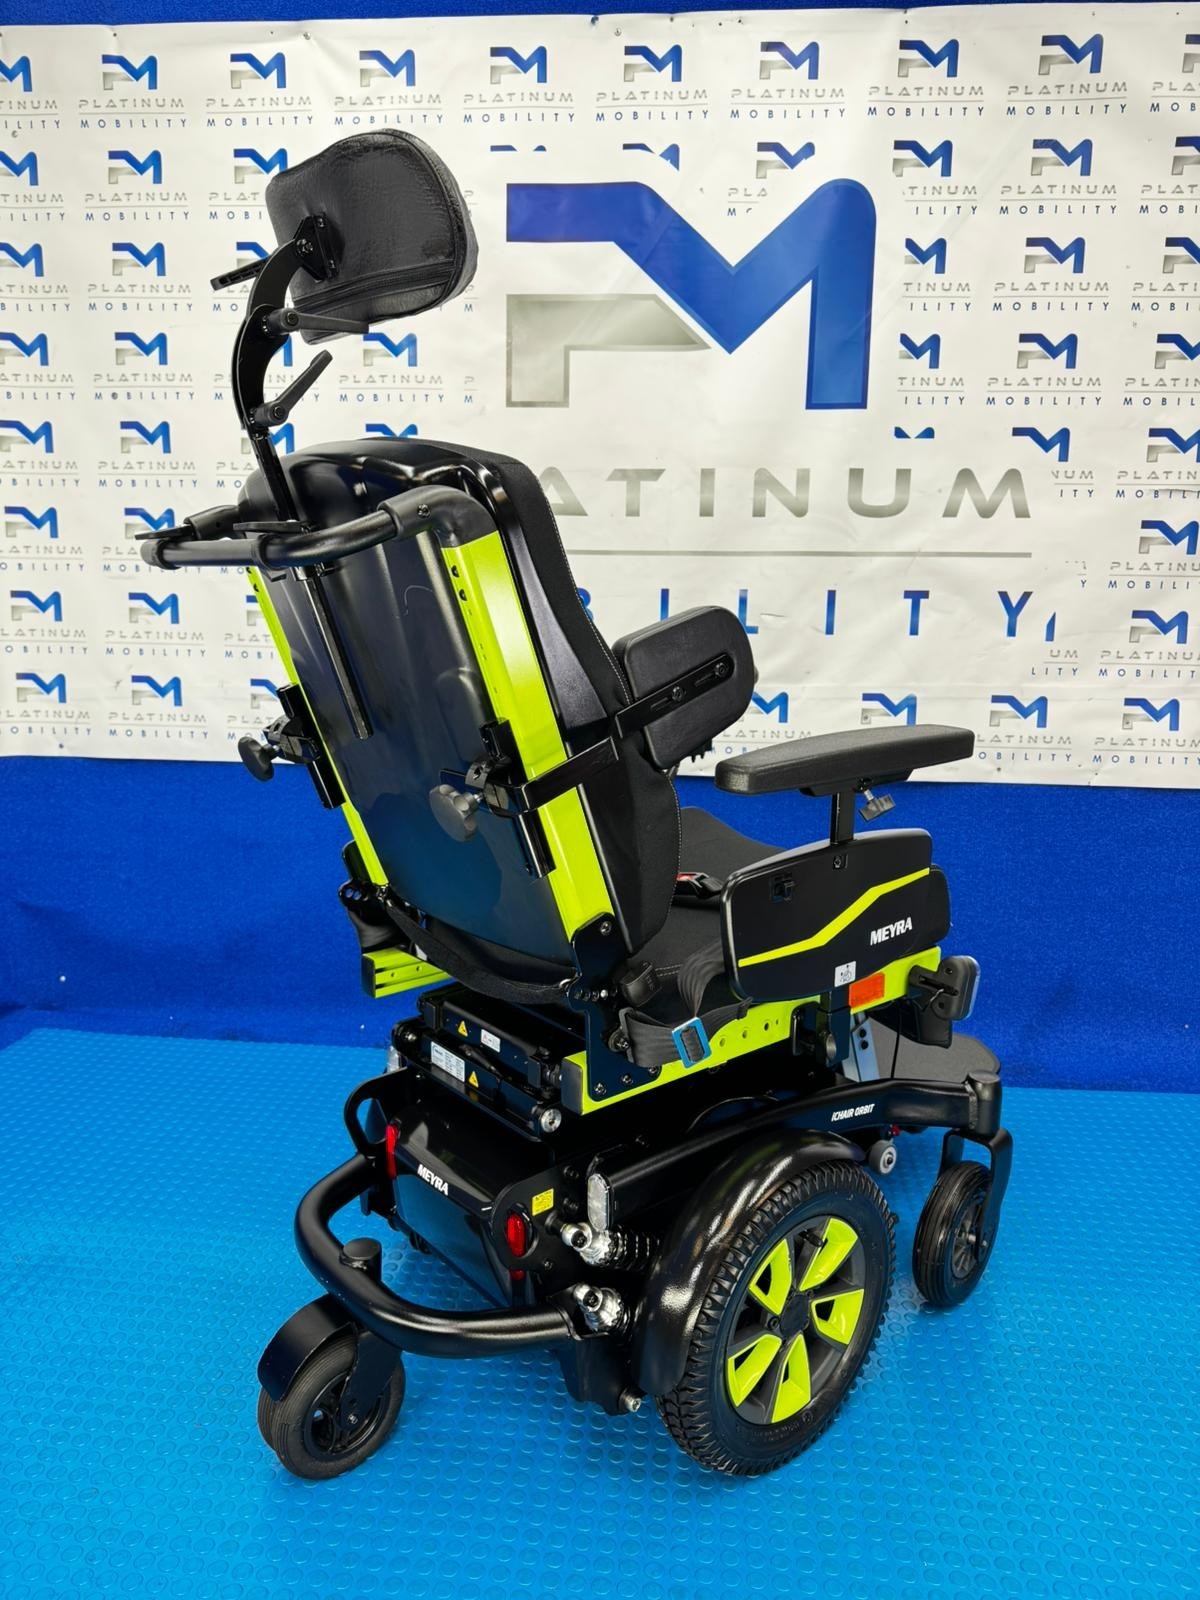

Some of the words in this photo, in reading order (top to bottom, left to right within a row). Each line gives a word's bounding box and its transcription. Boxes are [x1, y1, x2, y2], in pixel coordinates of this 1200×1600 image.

[731, 88, 845, 99] PLATINUM
[868, 86, 984, 96] PLATINUM
[1008, 81, 1128, 97] PLATINUM
[333, 94, 442, 105] PLATINUM
[464, 91, 573, 103] PLATINUM
[596, 89, 708, 103] PLATINUM
[78, 98, 184, 111] PLATINUM
[205, 96, 312, 108] PLATINUM
[730, 108, 845, 119] MOBILITY
[867, 106, 984, 117] MOBILITY
[1006, 104, 1127, 116] MOBILITY
[207, 116, 313, 127] MOBILITY
[334, 114, 443, 125] MOBILITY
[463, 112, 574, 123] MOBILITY
[596, 110, 708, 122] MOBILITY
[80, 118, 186, 128] MOBILITY
[902, 183, 978, 197] TINUM
[1000, 184, 1118, 197] PLATINUM
[84, 192, 188, 203] PLATINUM
[999, 204, 1117, 215] MOBILITY
[0, 212, 65, 221] ILITY
[85, 211, 189, 221] MOBILITY
[88, 282, 191, 293] PLATINUM
[994, 280, 1112, 293] PLATINUM
[88, 302, 192, 311] MOBILITY
[992, 301, 1109, 311] MOBILITY
[1131, 302, 1200, 311] MOBI
[93, 372, 193, 383] PLATINUM
[339, 374, 443, 384] PLATINUM
[987, 377, 1101, 389] PLATINUM
[339, 393, 444, 402] MOBILITY
[986, 396, 1101, 406] MOBILITY
[98, 461, 195, 470] PLATINUM
[0, 478, 80, 487] BILITY
[99, 479, 197, 488] MOBILITY
[1108, 580, 1200, 590] MOBILI
[105, 630, 204, 640] PLATINUM
[106, 648, 206, 657] MOBILITY
[1100, 650, 1200, 661] PLATINU
[108, 712, 207, 723] PLATINUM
[109, 729, 208, 739] MOBILITY
[870, 916, 913, 946] MEYRA
[854, 1103, 876, 1117] ORBIT
[417, 1163, 449, 1196] MEYRA
